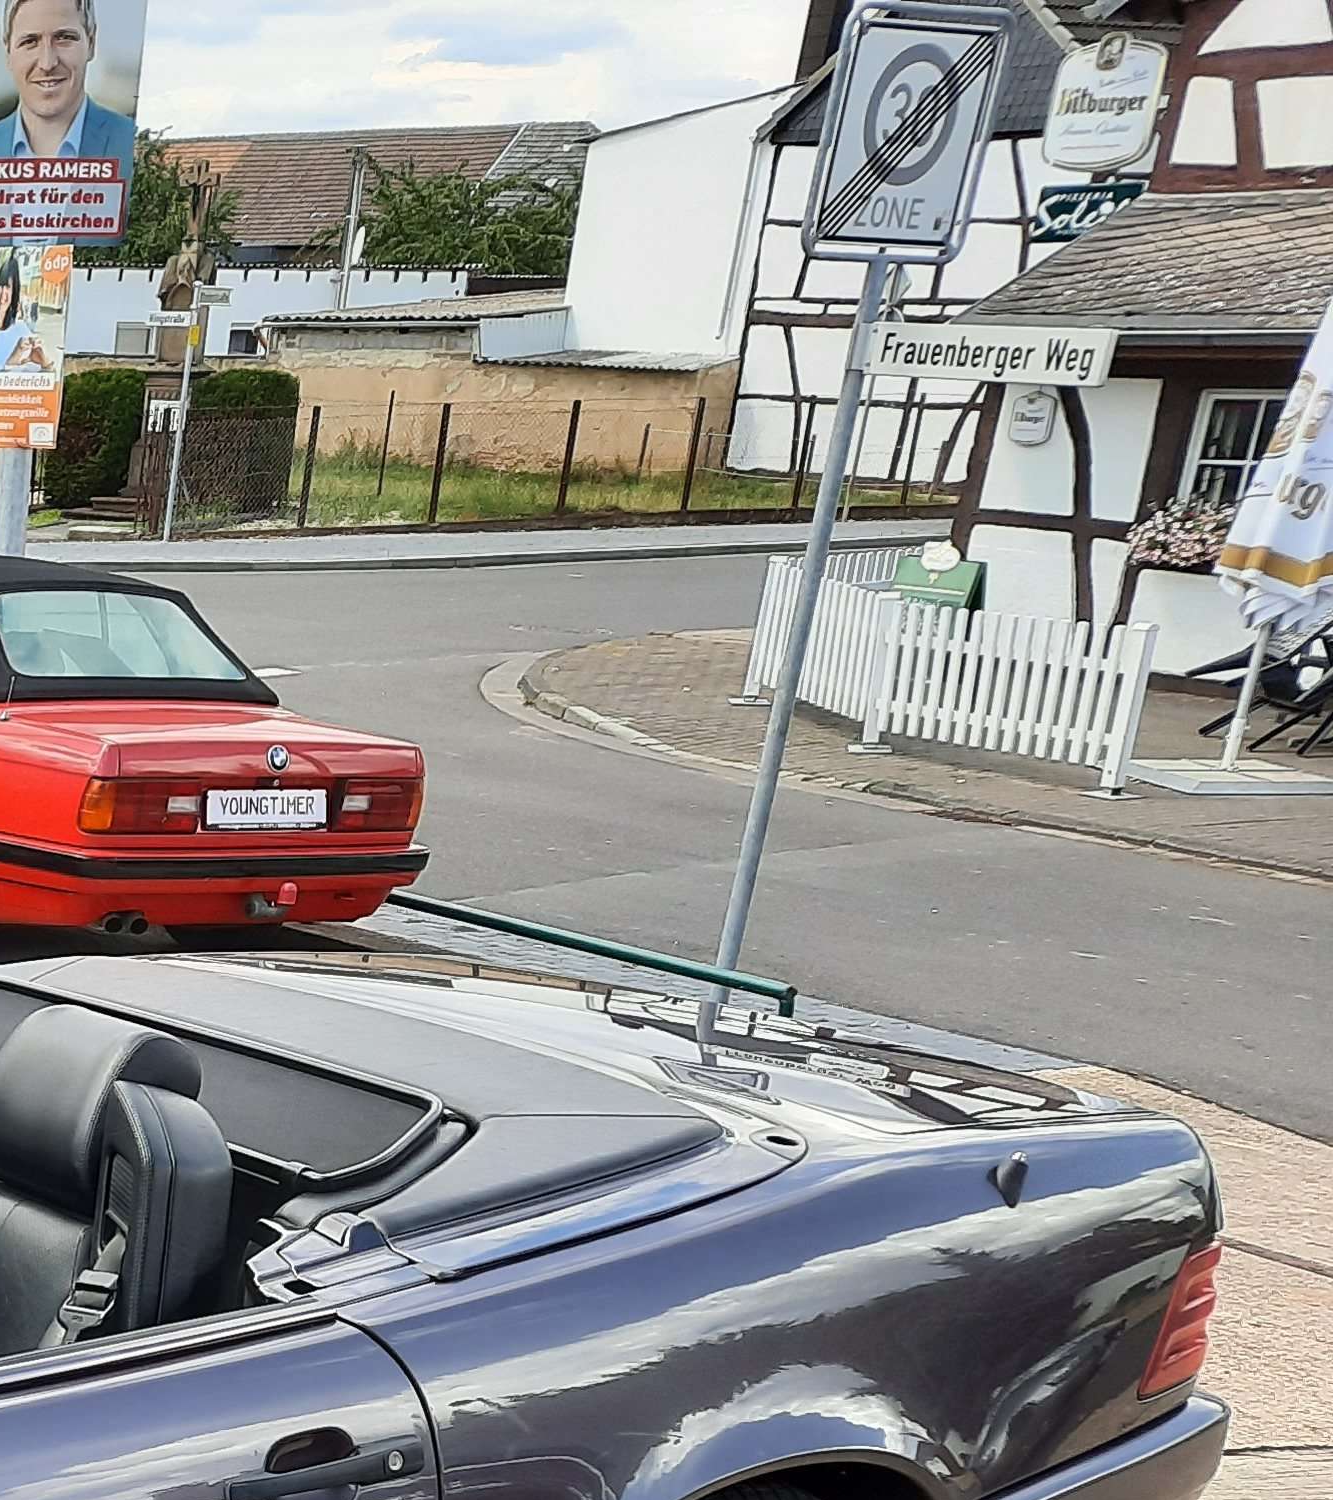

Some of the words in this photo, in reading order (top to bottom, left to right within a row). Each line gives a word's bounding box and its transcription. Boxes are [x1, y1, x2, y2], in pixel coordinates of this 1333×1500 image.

[39, 162, 113, 178] RAMERS
[40, 188, 68, 204] für
[71, 190, 104, 204] den
[11, 212, 115, 228] Euskirchen
[853, 196, 925, 229] ZONE
[880, 332, 1036, 378] Frauenberger
[1045, 338, 1096, 380] Weg
[220, 796, 315, 816] YOUNGTIMER
